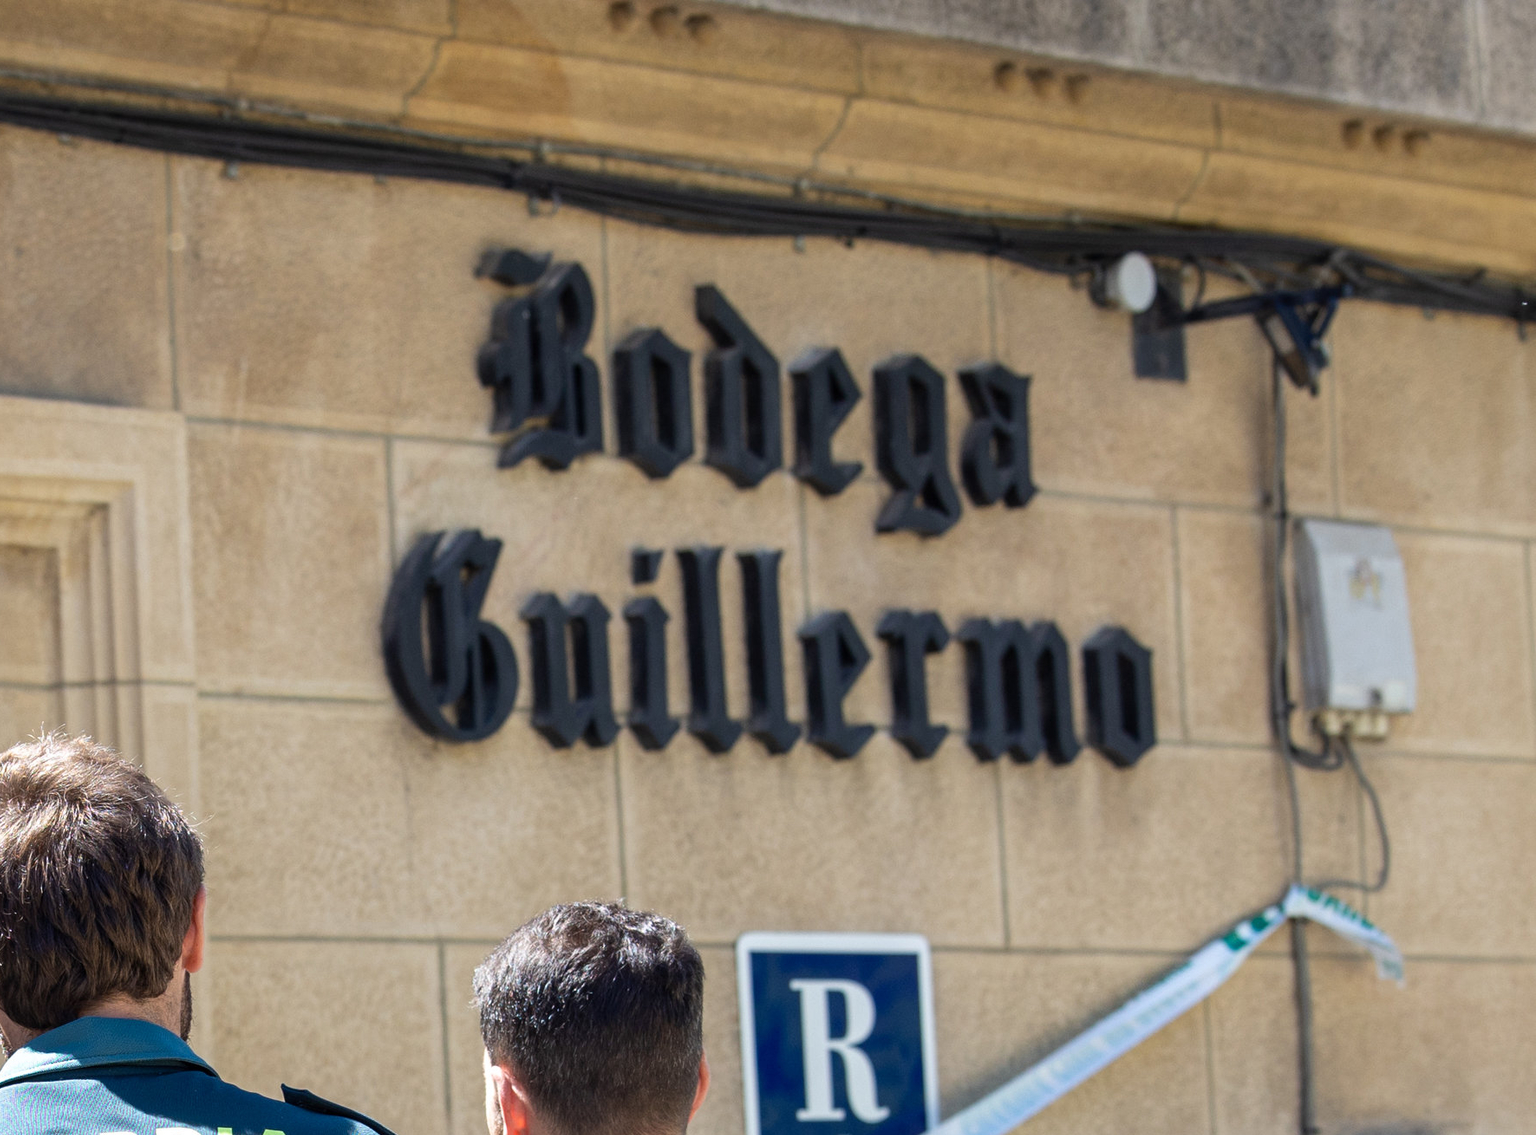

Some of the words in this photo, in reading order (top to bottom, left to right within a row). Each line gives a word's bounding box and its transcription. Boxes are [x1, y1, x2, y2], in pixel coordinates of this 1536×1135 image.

[474, 248, 1038, 538] Bodega
[381, 528, 1156, 769] Guillermo
[789, 978, 890, 1124] R
